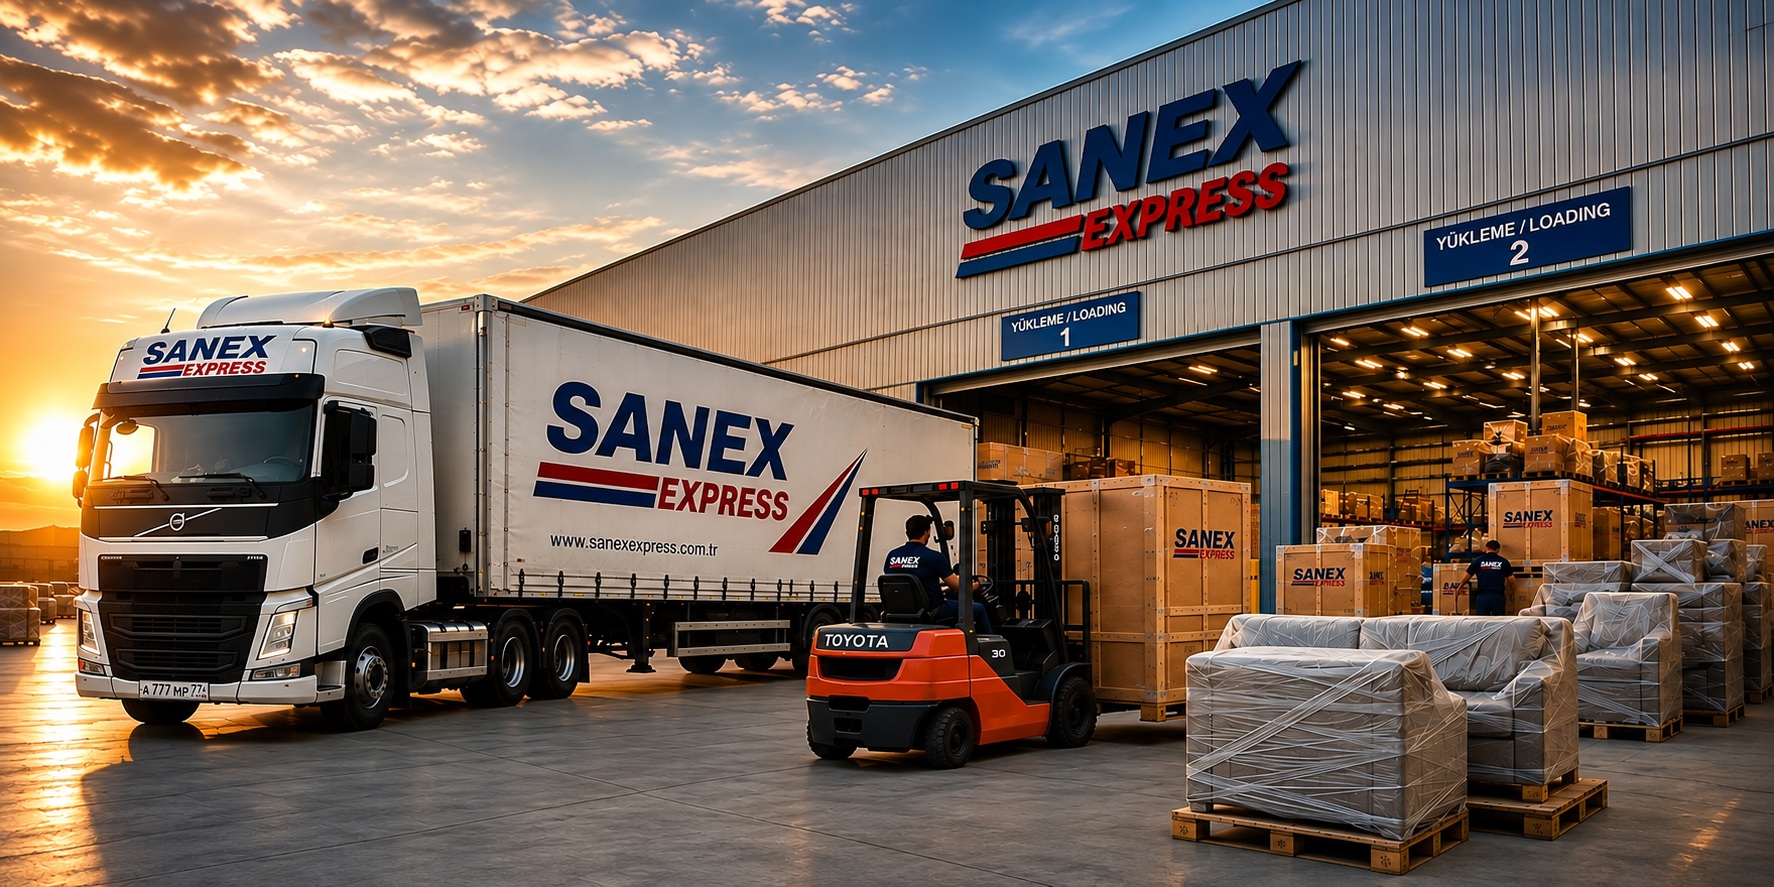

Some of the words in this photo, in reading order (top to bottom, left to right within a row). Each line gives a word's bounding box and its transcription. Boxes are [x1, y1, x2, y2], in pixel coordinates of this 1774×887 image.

[963, 59, 1302, 230] SANEX
[1081, 162, 1289, 252] EXPRESS
[1436, 222, 1515, 251] YÜKLEME
[1519, 220, 1526, 234] /
[1529, 202, 1611, 233] LOADING
[1509, 239, 1529, 266] 2
[1011, 312, 1064, 333] YÜKLEME
[1066, 311, 1072, 323] /
[1073, 302, 1126, 322] LOADING
[1060, 327, 1070, 347] 1
[143, 335, 277, 365] SANEX
[182, 361, 267, 376] EXPRESS
[546, 381, 795, 481] SANEX
[658, 476, 789, 521] EXPRESS
[1503, 510, 1553, 523] SANEX
[550, 535, 718, 556] www.sanexexpress.com.tr
[1174, 528, 1236, 549] SANEX
[890, 556, 920, 565] SANEX
[1199, 549, 1235, 560] EXPRESS
[1293, 567, 1346, 580] SANEX
[824, 634, 888, 648] TOYOTA
[991, 649, 1006, 658] 30
[142, 684, 149, 695] A
[152, 683, 171, 696] 777
